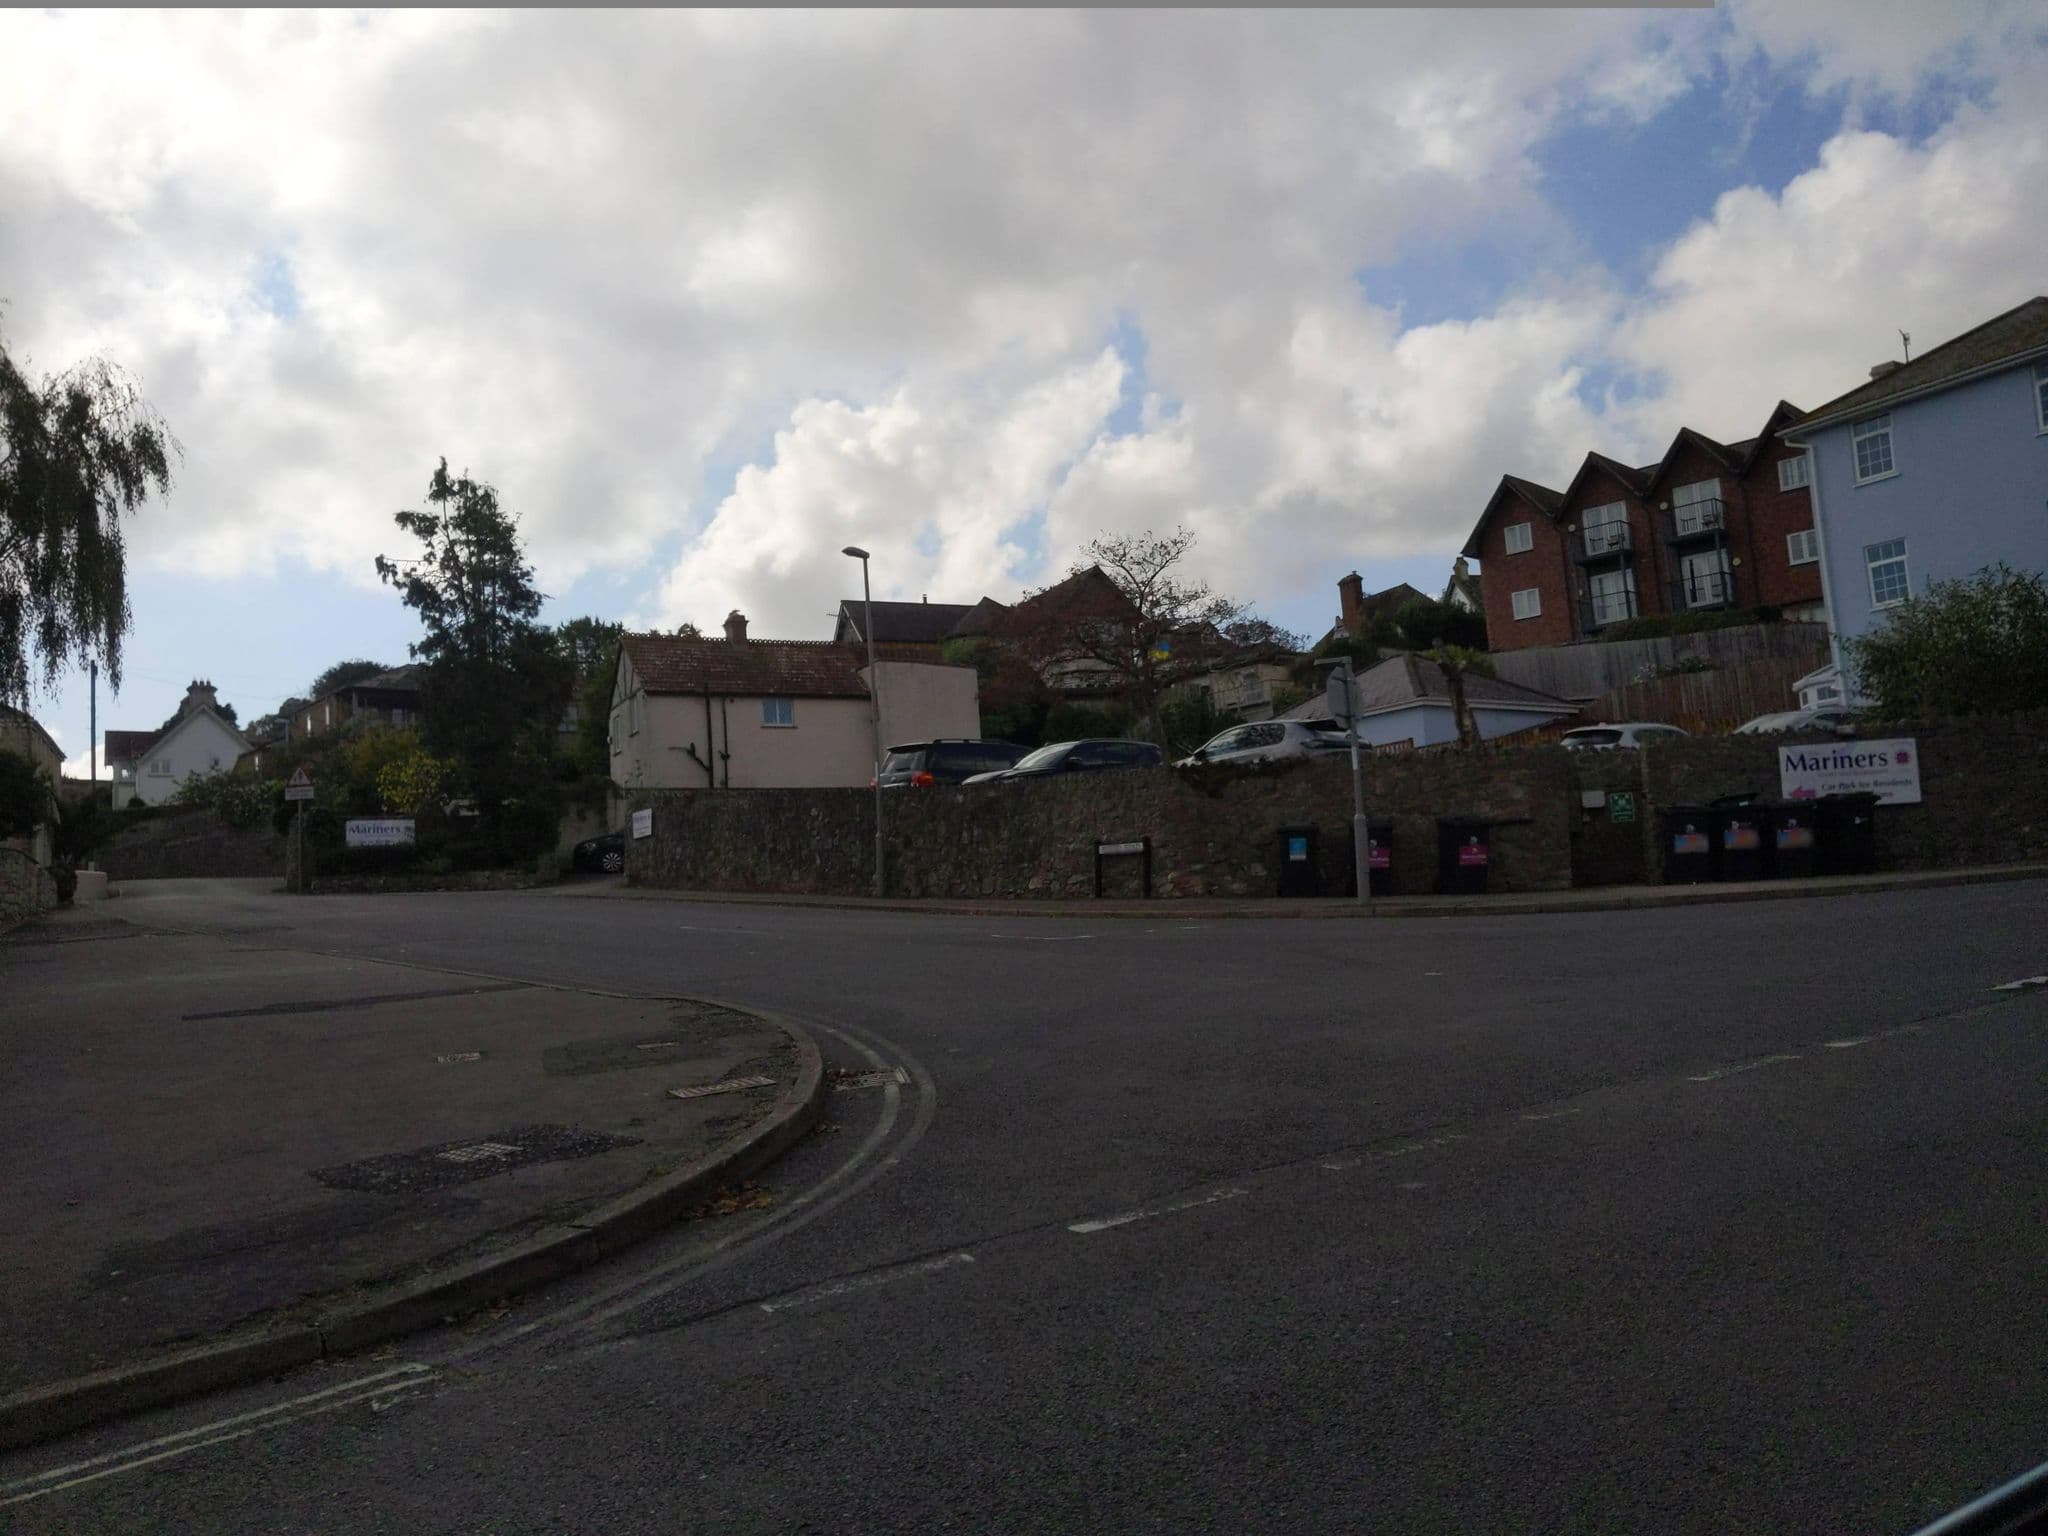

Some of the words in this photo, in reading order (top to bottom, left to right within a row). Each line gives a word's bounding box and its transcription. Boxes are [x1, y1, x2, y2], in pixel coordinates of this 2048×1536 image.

[1785, 750, 1888, 772] Mariners
[1821, 783, 1836, 791] Car
[1839, 781, 1856, 789] Park
[350, 823, 400, 834] Mariners
